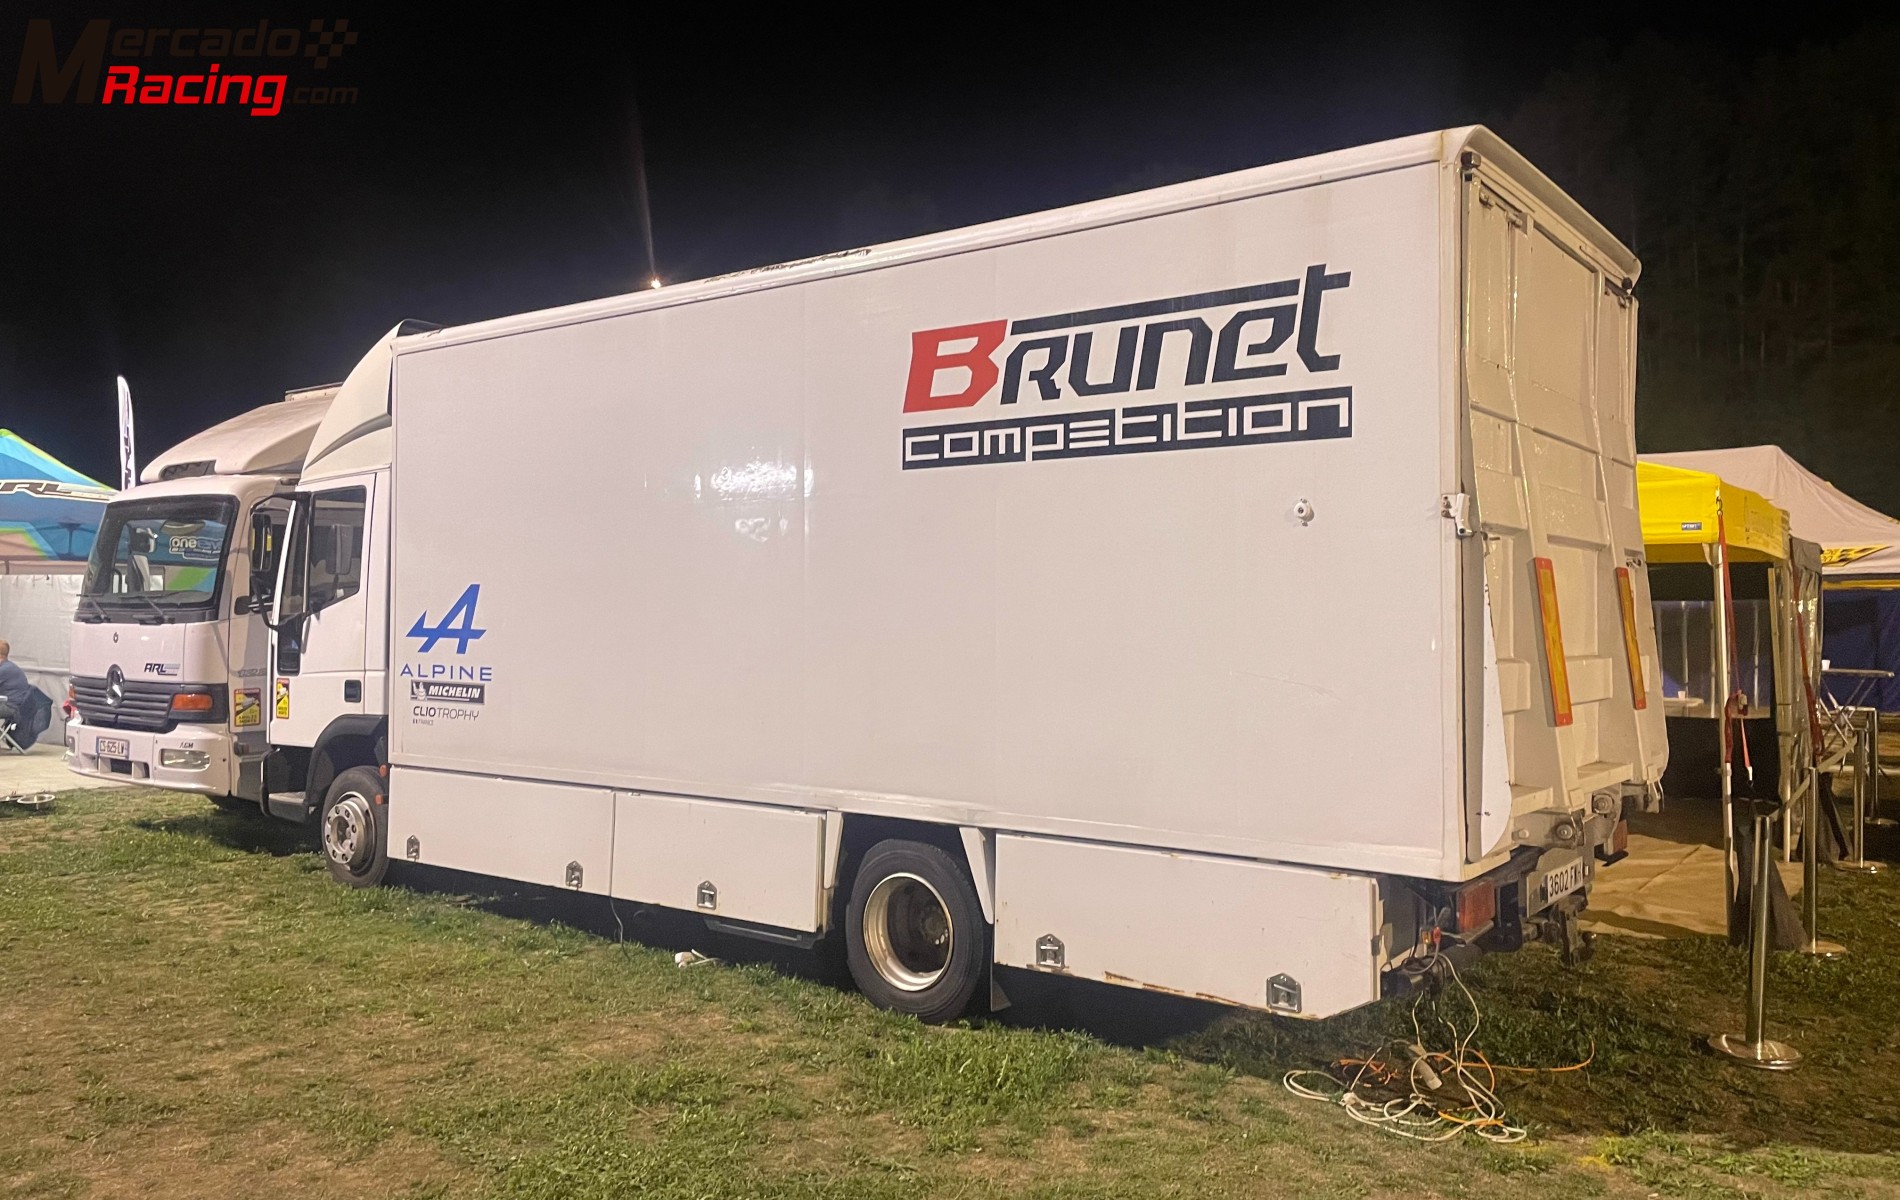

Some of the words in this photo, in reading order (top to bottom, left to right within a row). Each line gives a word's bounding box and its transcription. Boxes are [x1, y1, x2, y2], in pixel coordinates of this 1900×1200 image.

[143, 663, 178, 676] ARL
[400, 663, 493, 682] ALPINE
[428, 685, 481, 699] MICHELIN
[1549, 869, 1569, 897] 3602
